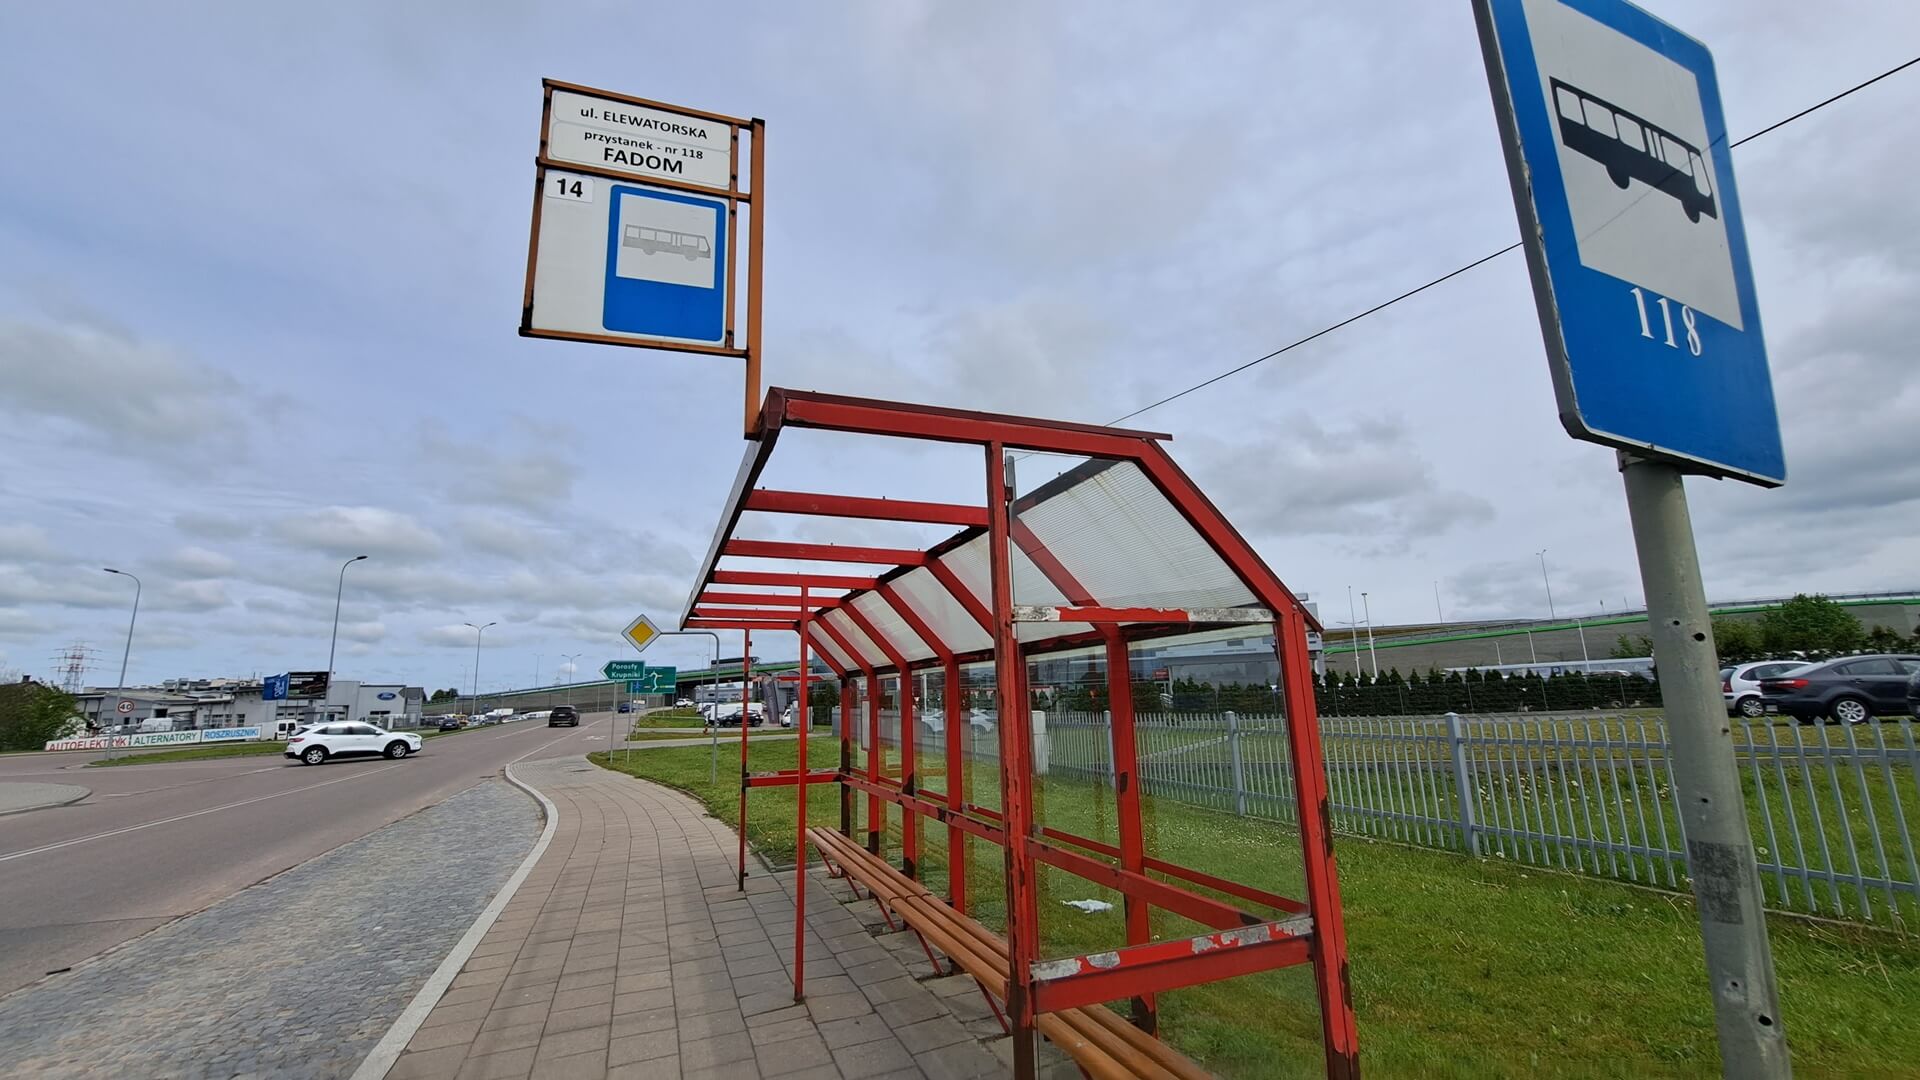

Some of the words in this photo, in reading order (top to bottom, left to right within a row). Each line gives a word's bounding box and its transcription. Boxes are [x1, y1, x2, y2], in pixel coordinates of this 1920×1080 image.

[580, 107, 598, 119] ul.
[603, 111, 707, 139] ELEWATORSKA
[584, 132, 653, 150] przystanek
[664, 146, 678, 155] nr
[682, 148, 703, 160] 118
[603, 147, 683, 174] FADOM
[556, 178, 583, 197] 14
[1630, 287, 1701, 356] 118
[611, 671, 640, 680] Krupniki
[119, 703, 132, 711] 40
[133, 732, 197, 745] ALTERNATORY
